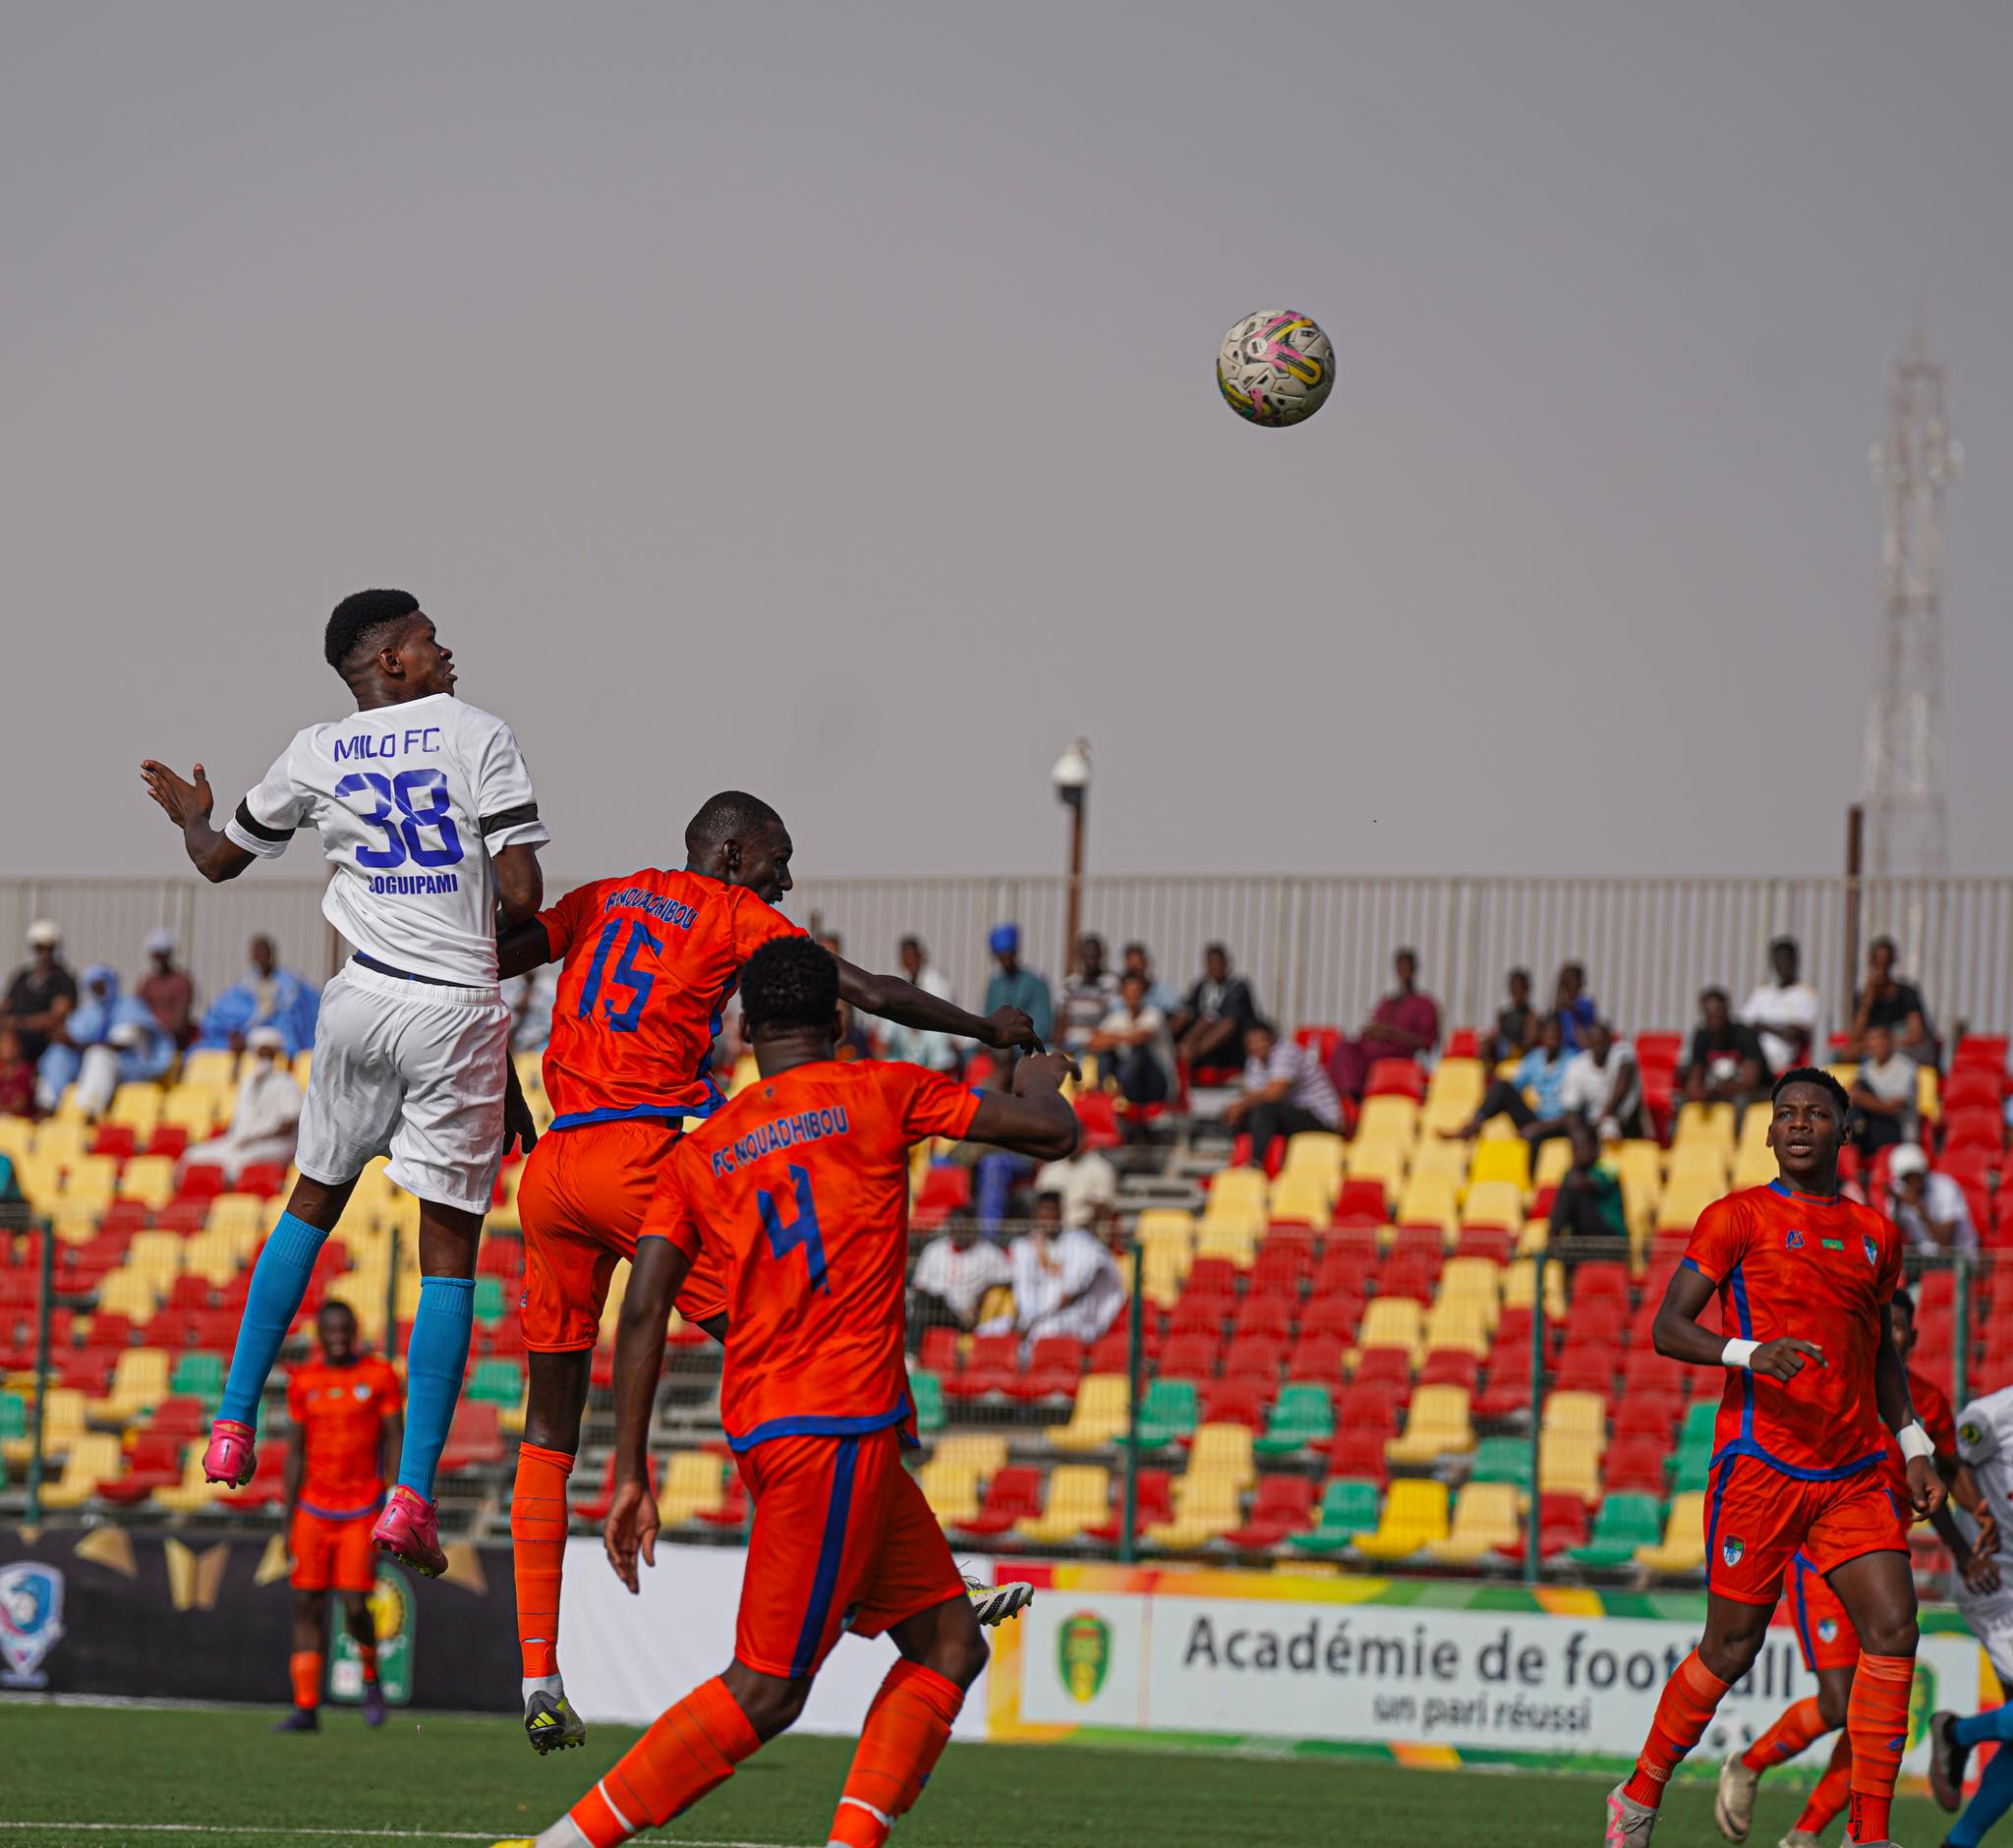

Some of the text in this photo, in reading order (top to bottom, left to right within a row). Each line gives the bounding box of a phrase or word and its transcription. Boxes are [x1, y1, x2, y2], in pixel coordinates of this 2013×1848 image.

[334, 727, 440, 762] MILO FC
[334, 768, 465, 869] 38
[367, 873, 459, 895] SOGUIPAMI
[578, 917, 664, 1033] 15
[712, 1104, 849, 1179] FC NOUADHIBOU
[757, 1163, 831, 1296] 4
[1182, 1614, 1459, 1681] Académie
[1477, 1626, 1545, 1685] de
[1373, 1691, 1592, 1736] un pari réussi
